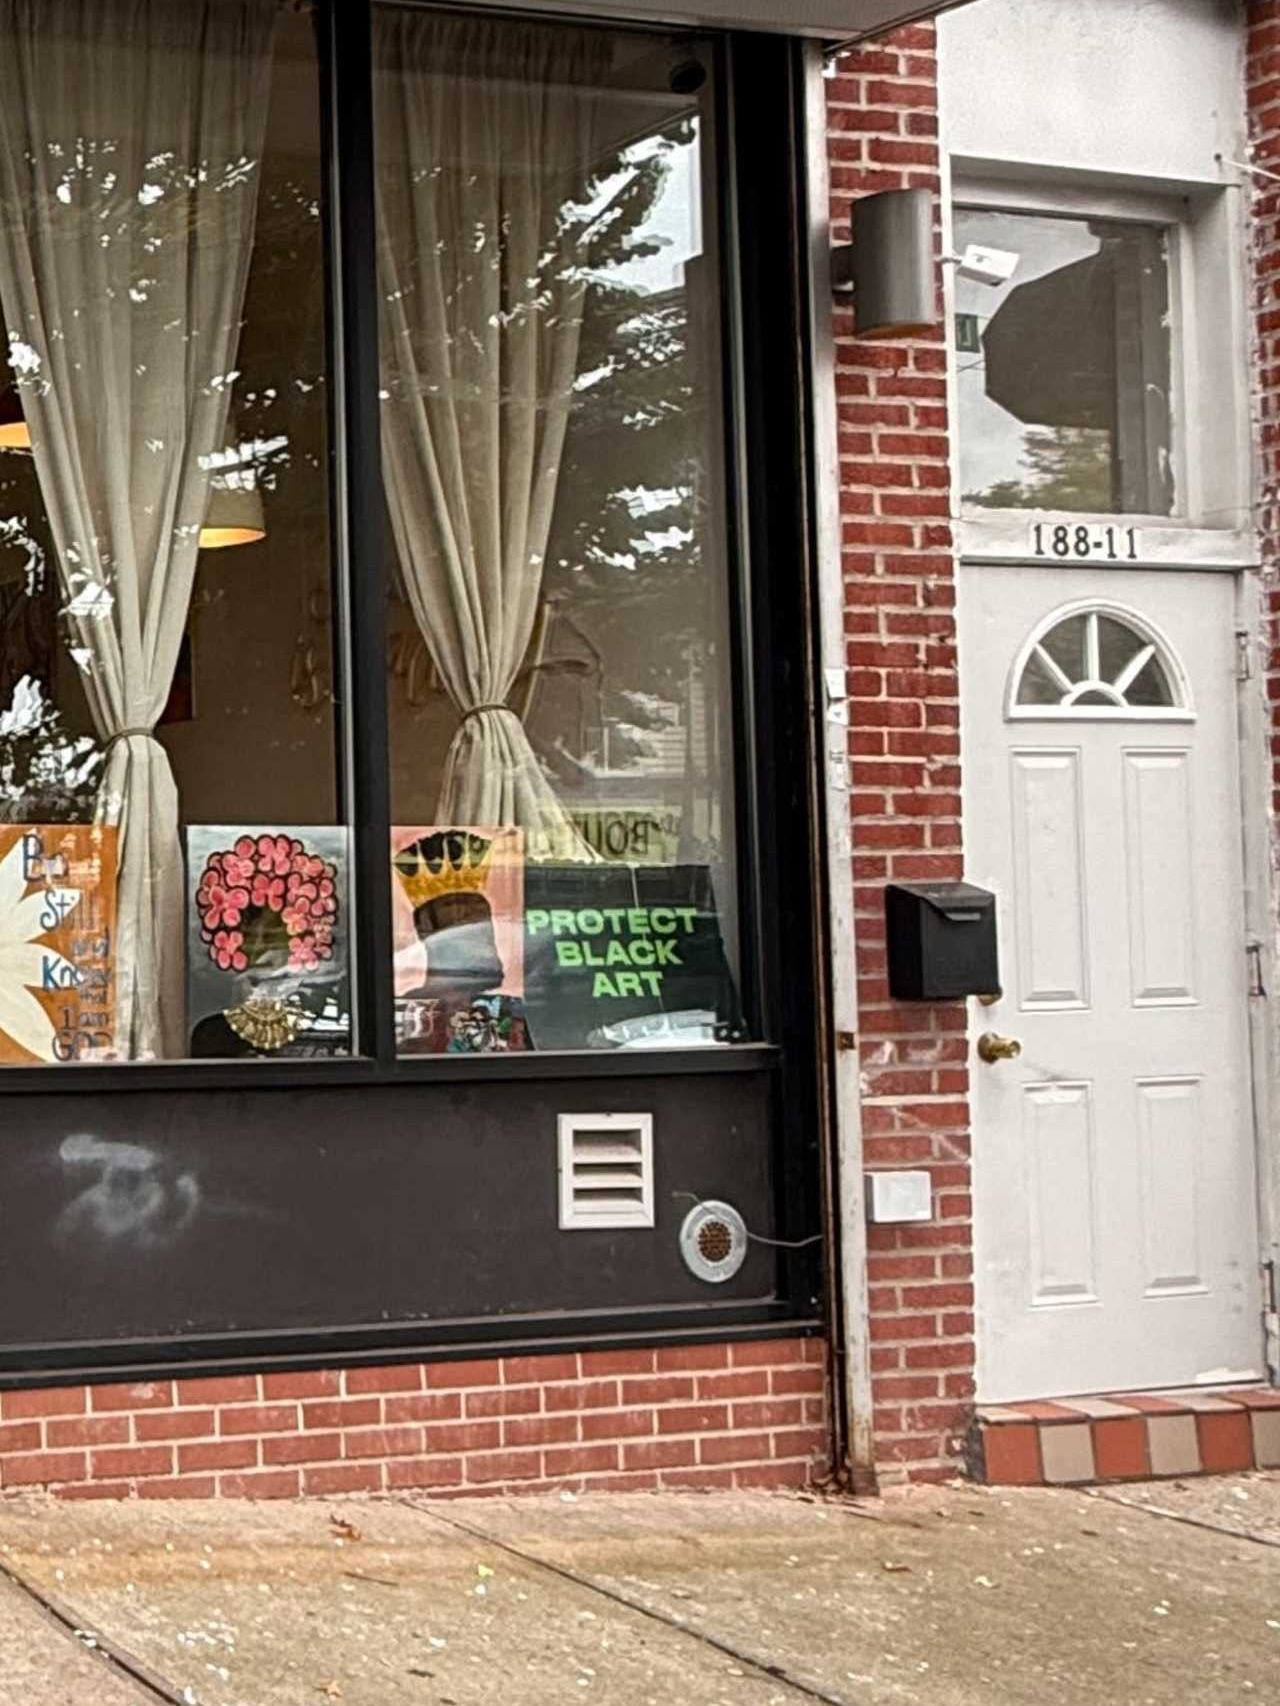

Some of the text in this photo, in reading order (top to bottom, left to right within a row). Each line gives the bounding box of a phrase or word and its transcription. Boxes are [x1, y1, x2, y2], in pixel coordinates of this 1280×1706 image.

[1033, 524, 1138, 559] 188-11
[525, 907, 697, 936] PROTECT
[555, 939, 684, 967] BLACK
[592, 970, 664, 998] ART
